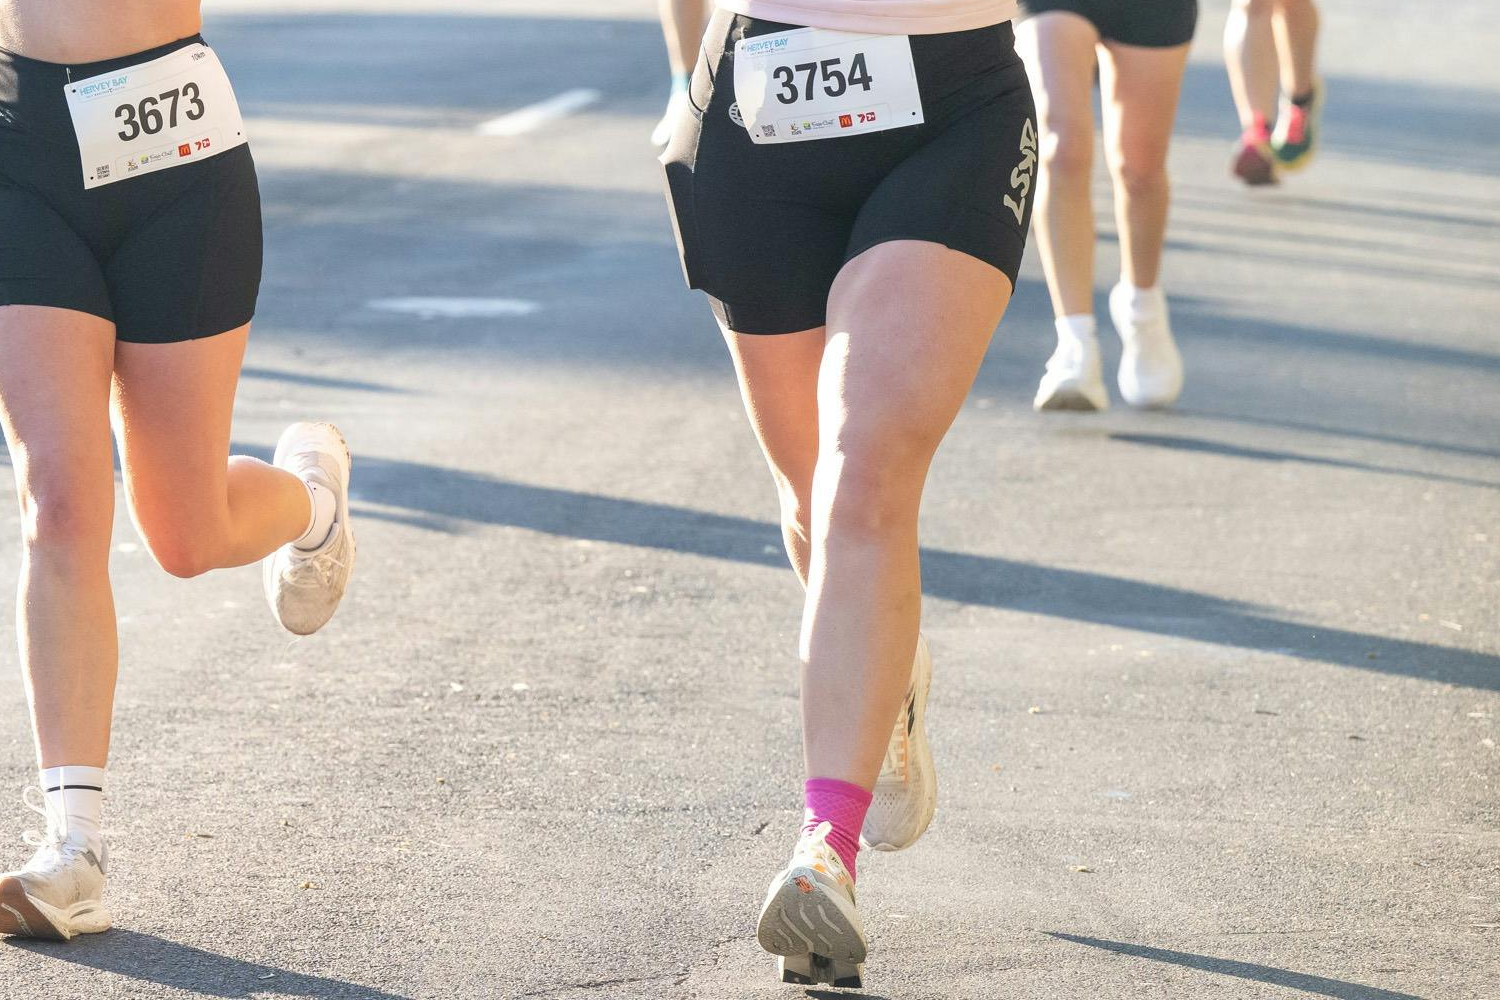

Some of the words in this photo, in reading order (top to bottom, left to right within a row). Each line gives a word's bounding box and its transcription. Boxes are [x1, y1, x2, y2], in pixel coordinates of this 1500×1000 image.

[191, 50, 206, 62] 10km
[746, 39, 774, 53] HERVEY
[774, 37, 789, 48] BAY
[79, 79, 110, 97] HERVEY
[111, 75, 128, 87] BAY
[772, 52, 873, 105] 3754
[114, 81, 206, 142] 3673
